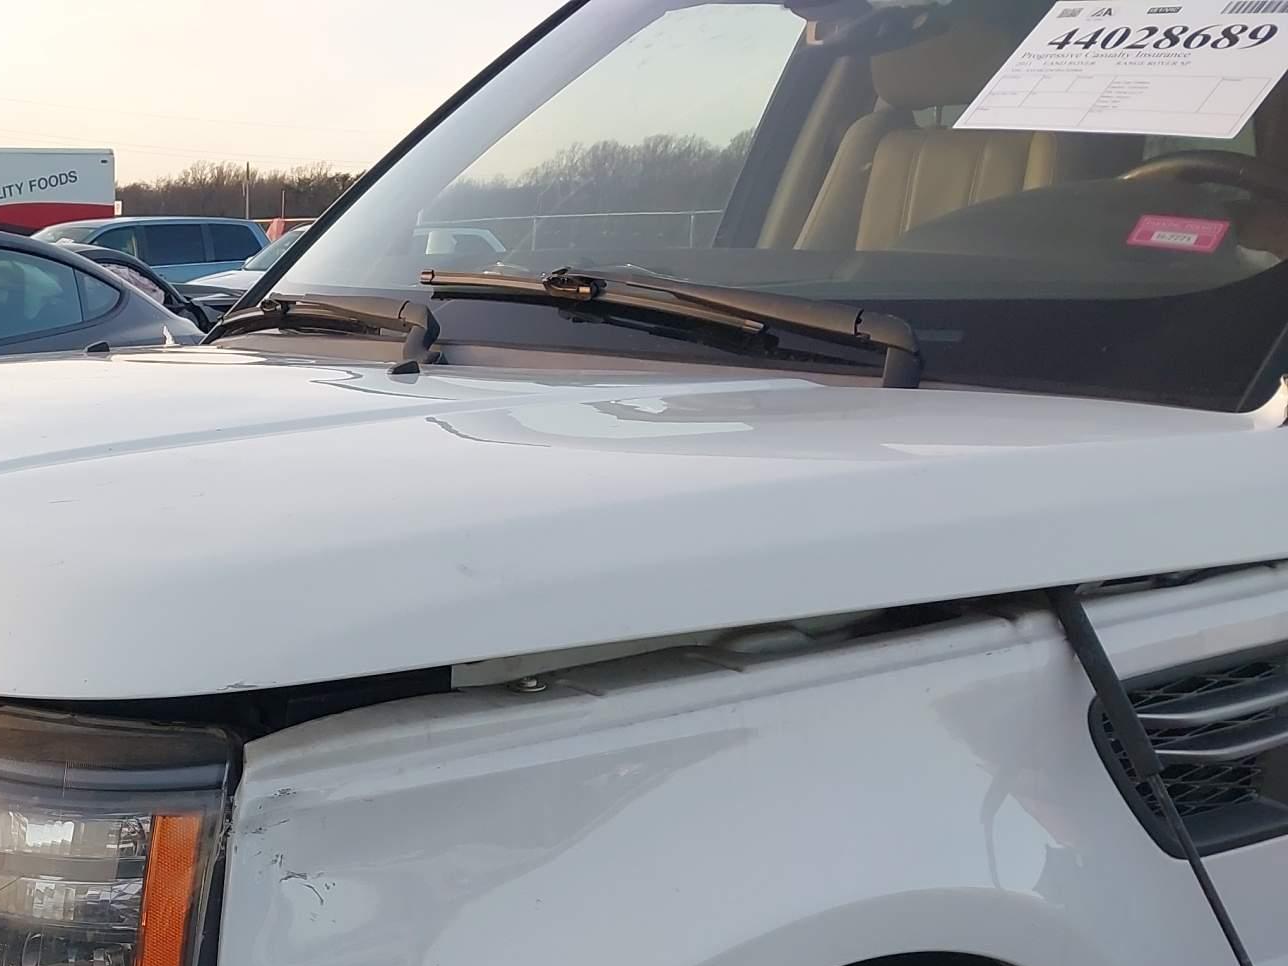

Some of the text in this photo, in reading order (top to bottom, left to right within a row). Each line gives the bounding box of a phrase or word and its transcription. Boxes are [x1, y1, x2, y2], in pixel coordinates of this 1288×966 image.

[1048, 24, 1278, 50] 44028689
[1020, 51, 1081, 60] Progressive
[1135, 50, 1192, 59] Insurance
[29, 170, 78, 193] FOODS
